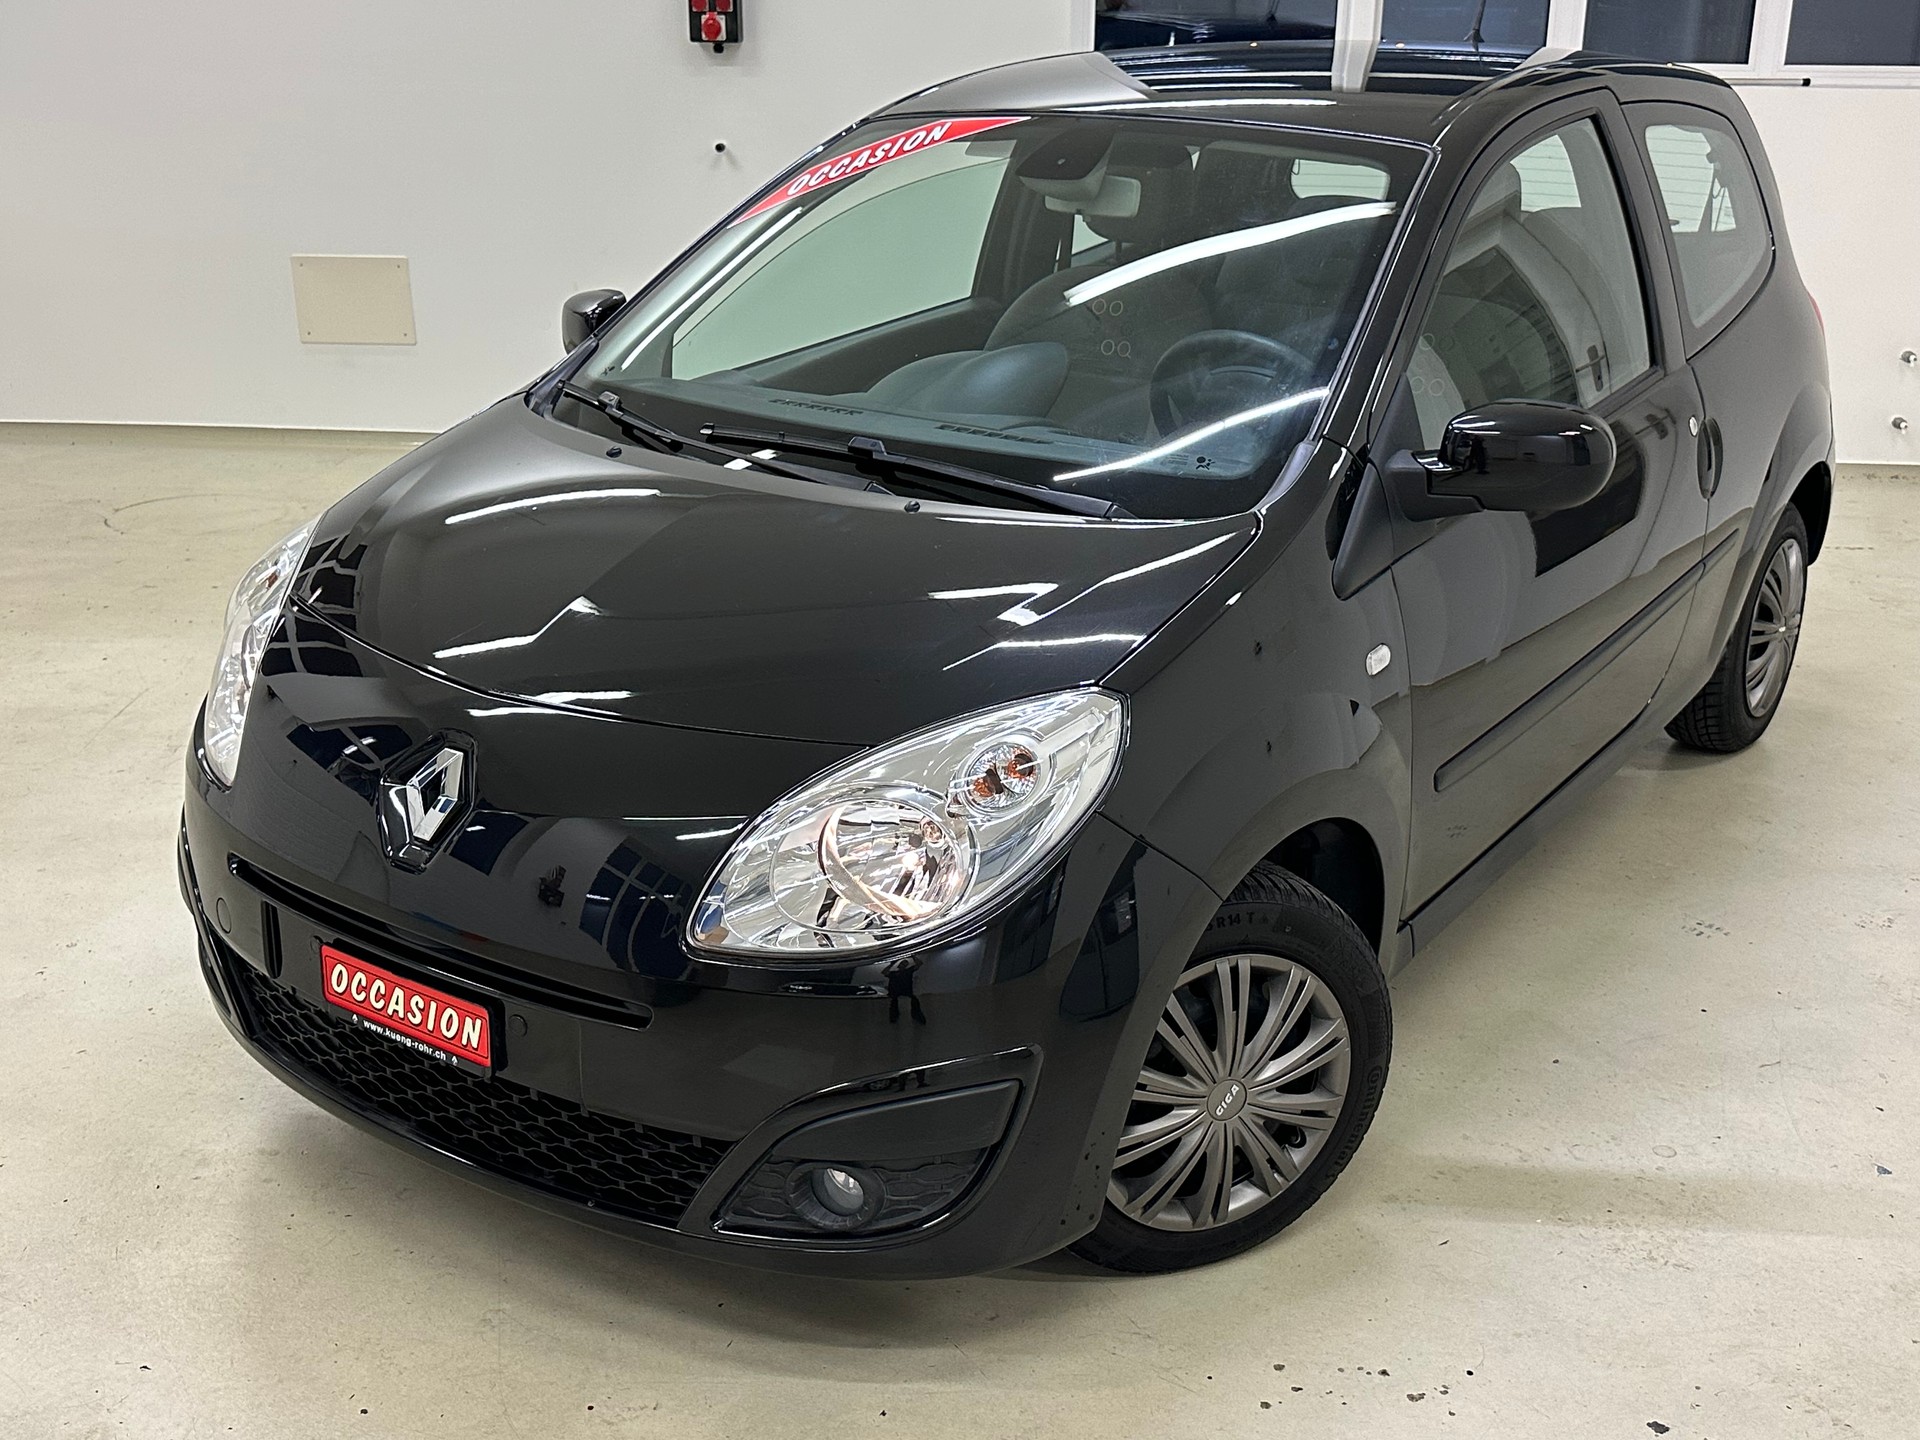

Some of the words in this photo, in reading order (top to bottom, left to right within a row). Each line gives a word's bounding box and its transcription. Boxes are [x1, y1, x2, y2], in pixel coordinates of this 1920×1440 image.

[787, 121, 952, 196] OCCASION
[331, 963, 482, 1049] OCCASION
[363, 1020, 446, 1060] www.kueng-rohr.ch
[1216, 1084, 1240, 1116] GIGA
